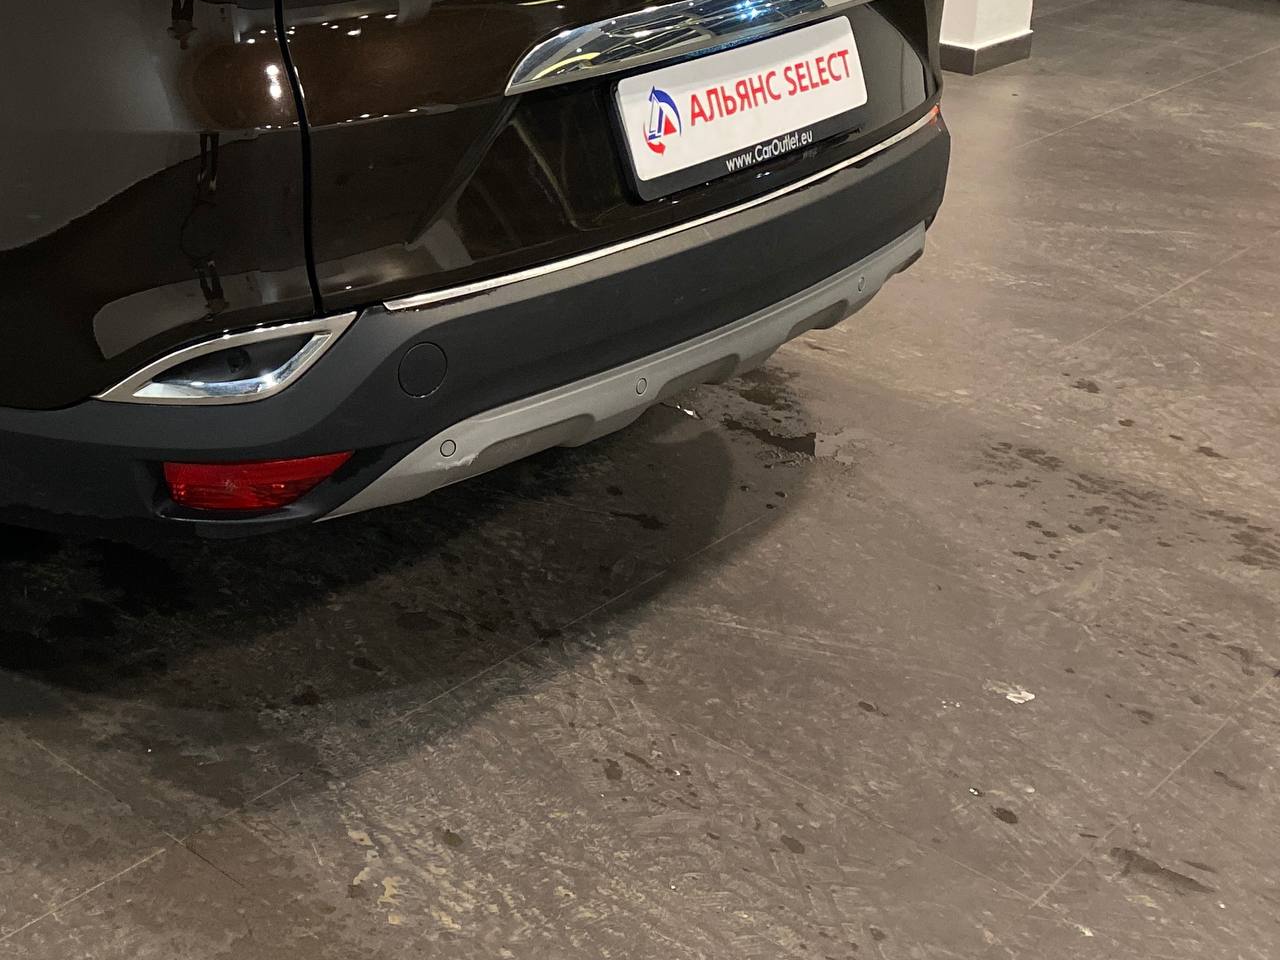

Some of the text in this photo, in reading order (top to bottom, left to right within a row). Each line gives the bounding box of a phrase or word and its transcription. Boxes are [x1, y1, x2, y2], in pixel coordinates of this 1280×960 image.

[690, 49, 851, 127] АЛЬЯНС SELECT
[726, 129, 813, 172] www.CarOutlet.eu
